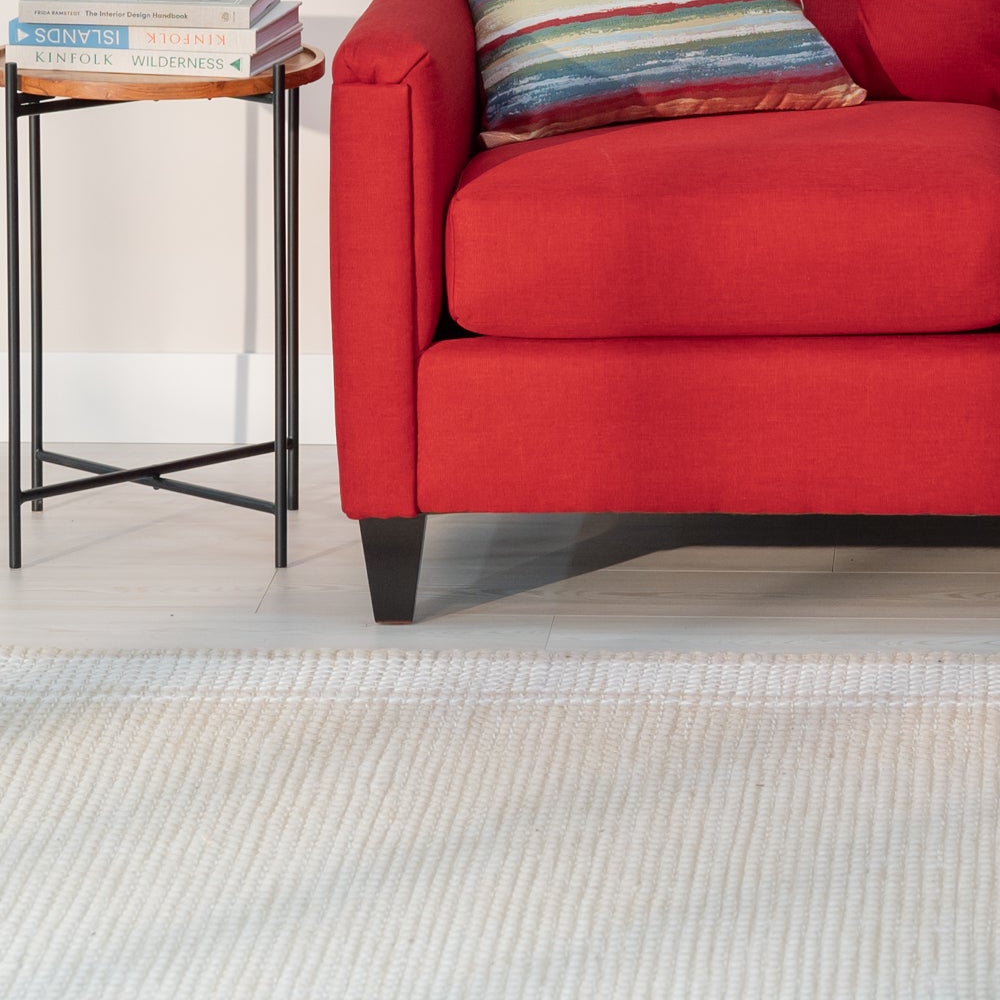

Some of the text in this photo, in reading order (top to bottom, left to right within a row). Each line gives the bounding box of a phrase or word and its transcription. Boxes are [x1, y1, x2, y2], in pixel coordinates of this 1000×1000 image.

[99, 10, 125, 18] Interior
[127, 11, 151, 20] Design
[152, 12, 188, 20] Handbook
[36, 27, 225, 45] KINFOLK ISLANDS
[35, 51, 224, 69] KINFOLK WILDERNESS
